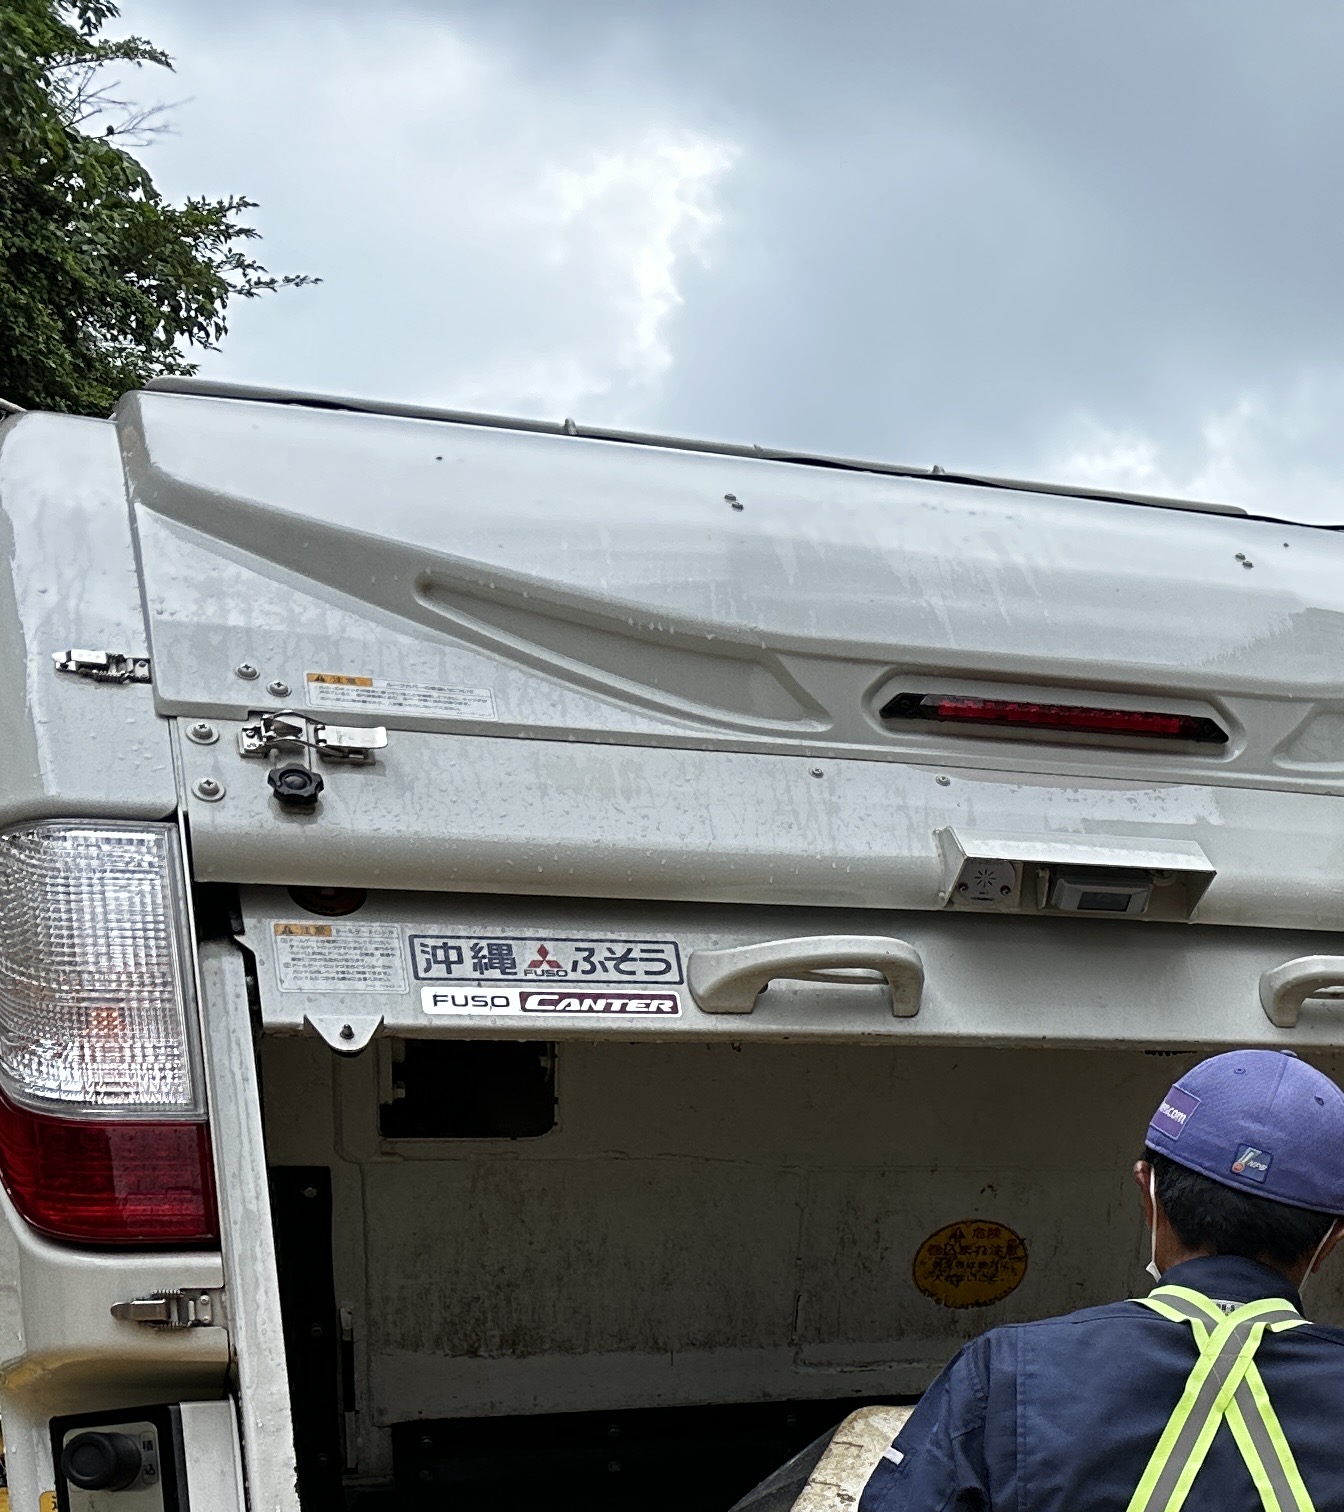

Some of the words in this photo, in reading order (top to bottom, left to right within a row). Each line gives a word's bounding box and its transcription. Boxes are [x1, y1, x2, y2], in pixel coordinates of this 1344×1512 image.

[419, 941, 518, 976] 沖縄
[570, 946, 673, 976] ふそう
[523, 968, 569, 978] FUSO
[432, 994, 511, 1009] FUSO
[524, 994, 675, 1012] CANTER
